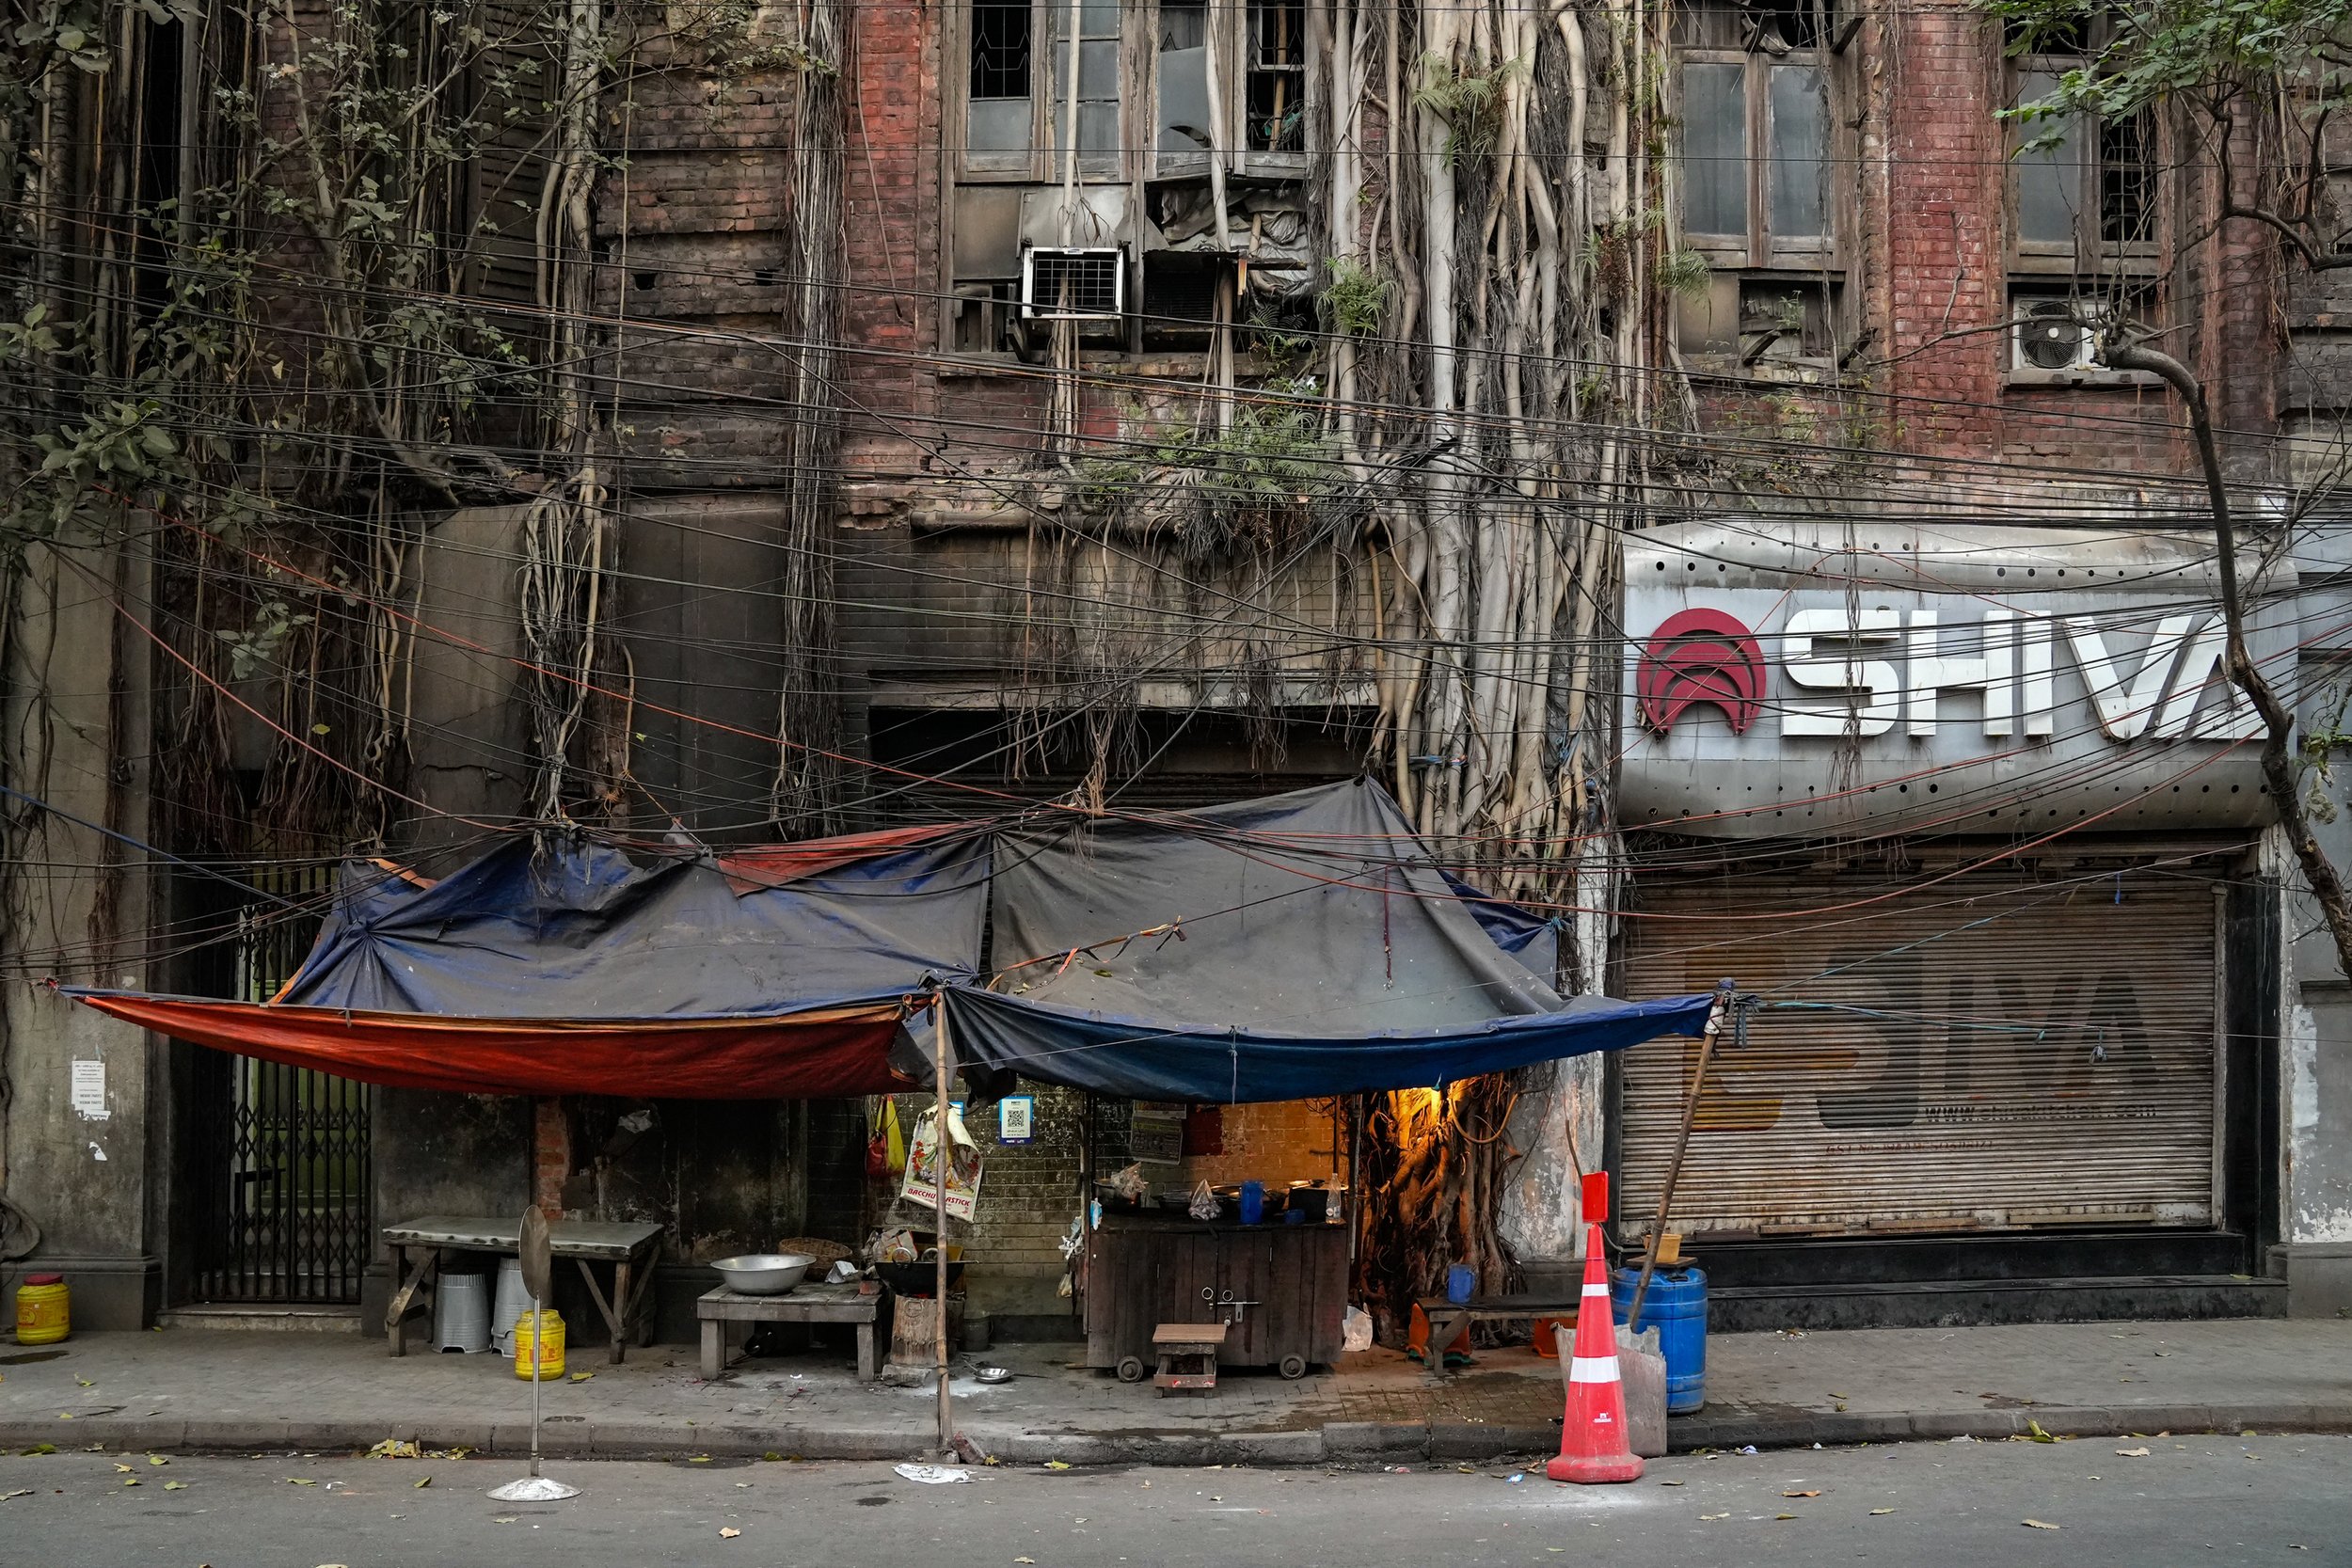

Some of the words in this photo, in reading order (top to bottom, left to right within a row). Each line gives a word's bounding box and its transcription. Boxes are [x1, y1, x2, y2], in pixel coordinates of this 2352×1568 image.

[1781, 609, 2269, 742] SHIVA
[907, 1187, 937, 1199] BACCHU
[945, 1196, 971, 1207] ASTICK
